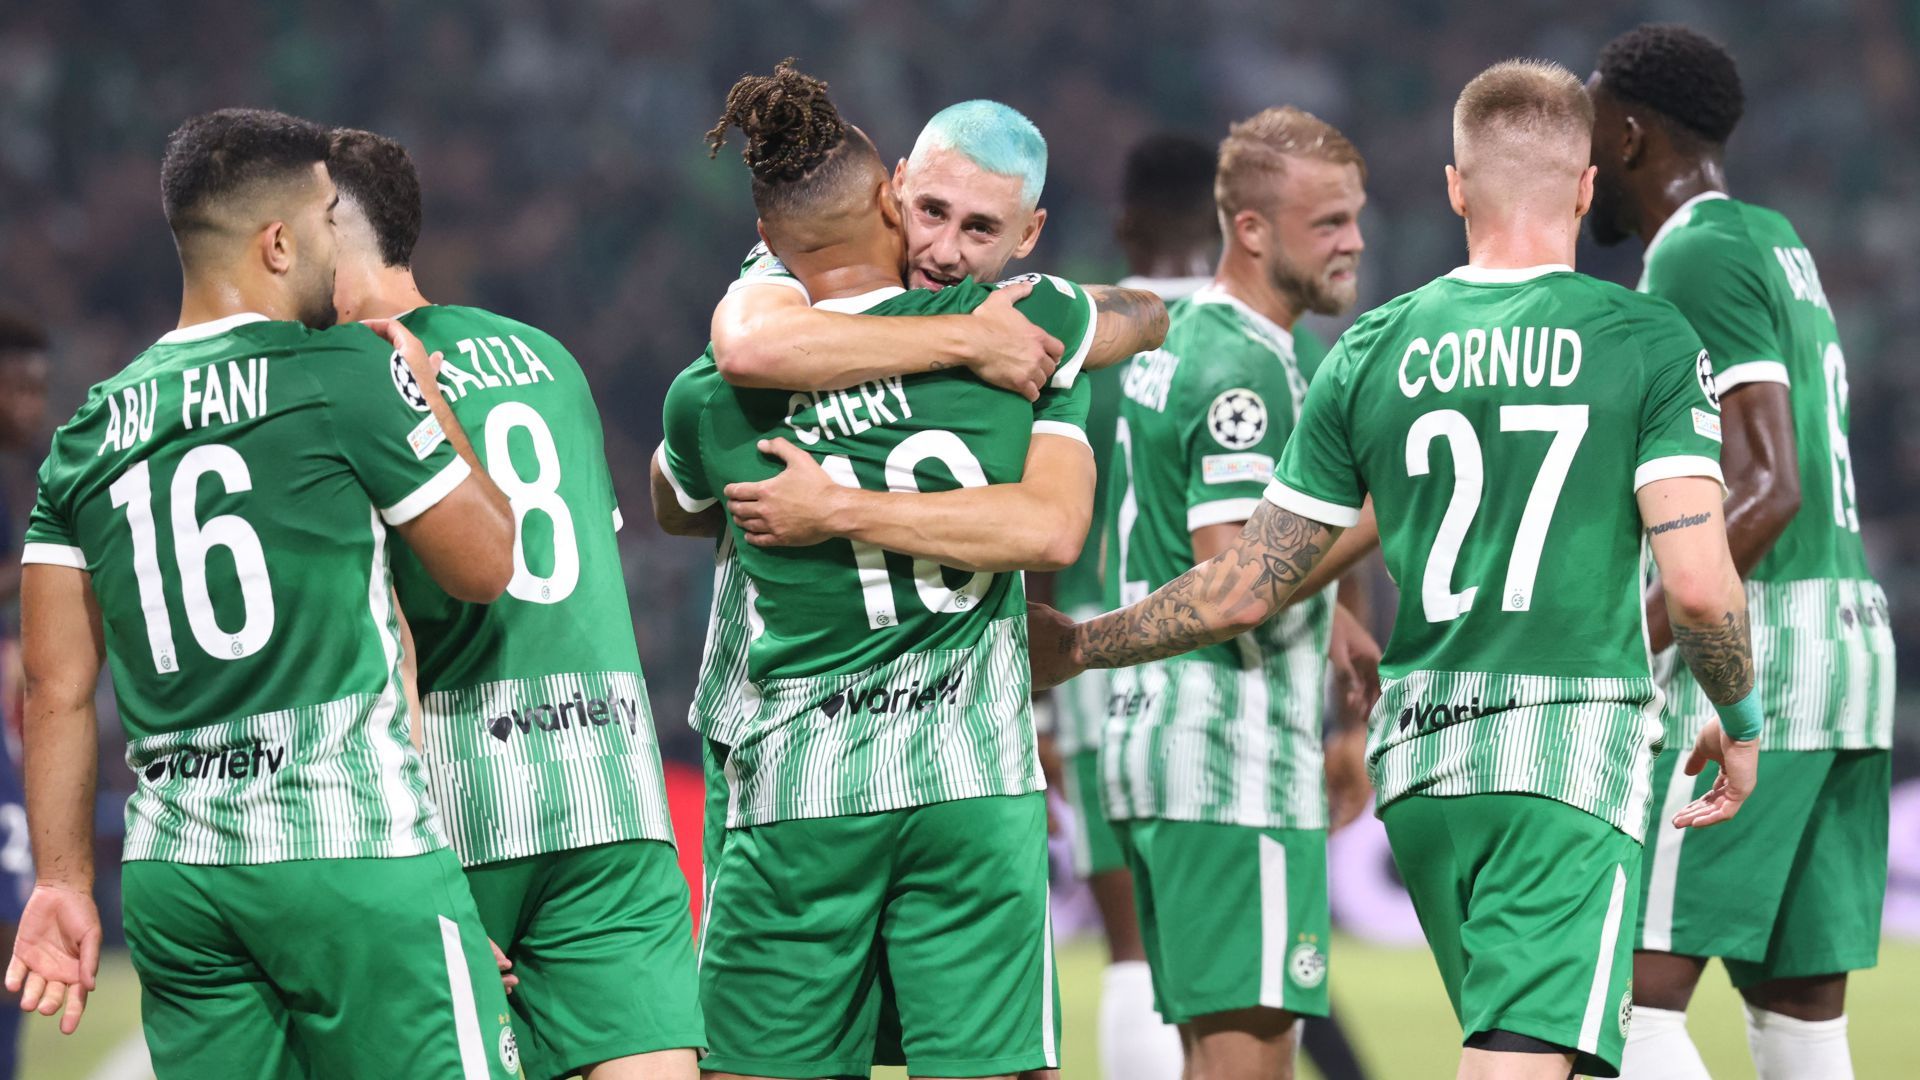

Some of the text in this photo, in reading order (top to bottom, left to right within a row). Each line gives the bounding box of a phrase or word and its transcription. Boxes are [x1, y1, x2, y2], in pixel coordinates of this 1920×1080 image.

[437, 334, 555, 403] AZIZA
[1399, 326, 1582, 398] CORNUD
[98, 357, 268, 456] ABU FANI
[784, 375, 913, 446] CHERY
[485, 401, 580, 604] 8
[1405, 404, 1589, 623] 27
[109, 443, 275, 674] 16
[511, 685, 636, 735] variety
[1415, 696, 1516, 731] vari
